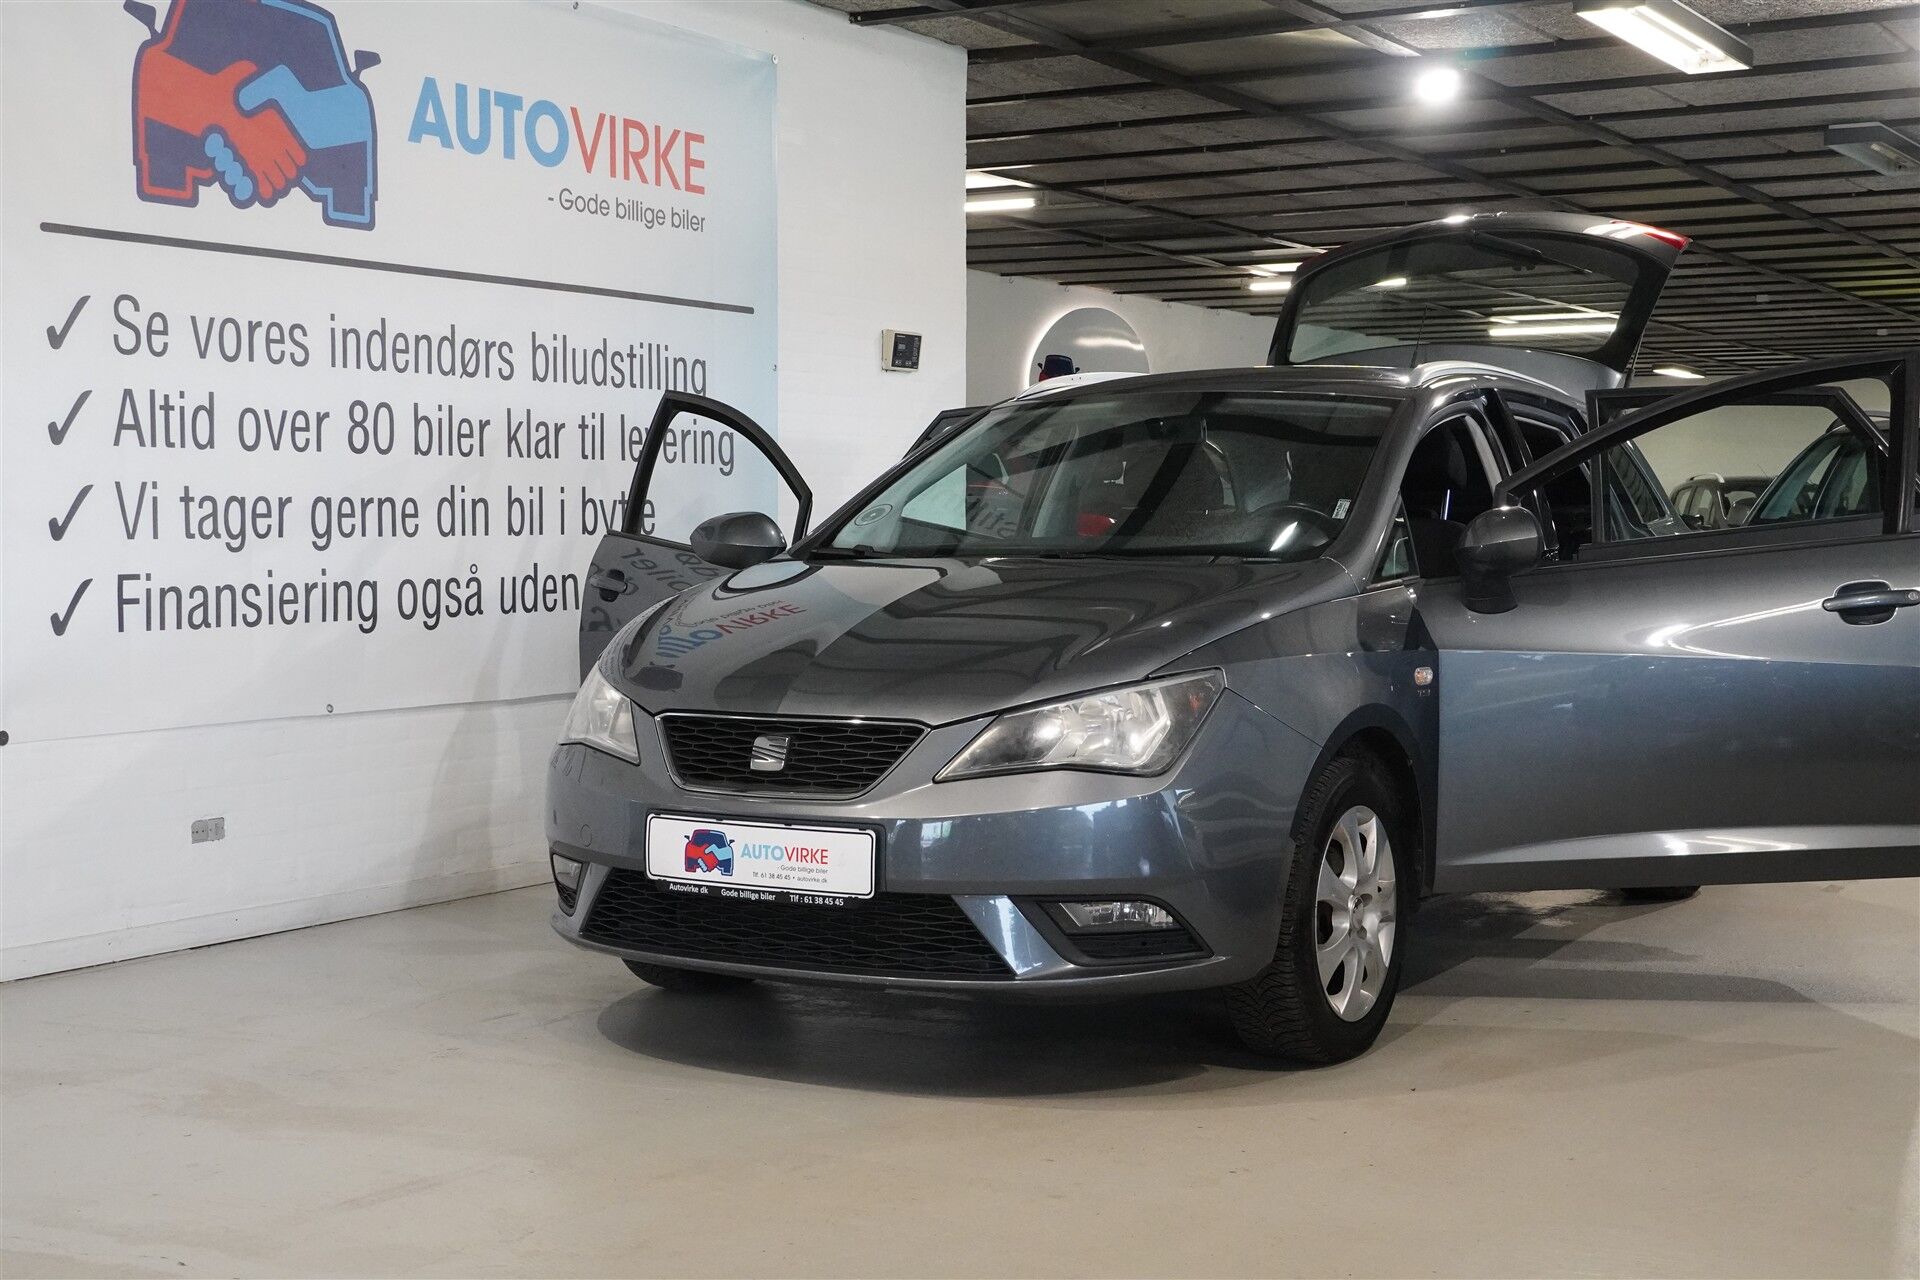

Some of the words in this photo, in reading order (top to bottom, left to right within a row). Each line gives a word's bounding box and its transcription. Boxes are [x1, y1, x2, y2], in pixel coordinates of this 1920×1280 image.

[408, 76, 705, 195] AUTOVIRKE
[559, 187, 610, 217] Gode
[615, 197, 666, 230] billige
[671, 206, 706, 233] biler
[113, 294, 169, 358] Se
[190, 315, 310, 367] vores
[330, 313, 515, 381] indendørs
[531, 331, 707, 397] biludstilling
[113, 388, 215, 451] Altid
[238, 407, 330, 454] over
[347, 400, 395, 456] 80
[413, 402, 490, 458] biler
[506, 407, 566, 460] klar
[577, 412, 605, 461] til
[620, 414, 735, 477] leering
[114, 480, 159, 540] Vi
[179, 485, 293, 553] tager
[310, 496, 419, 552] gerne
[437, 484, 489, 538] din
[507, 485, 544, 537] bil
[560, 486, 565, 535] i
[117, 568, 378, 635] Finansiering
[397, 563, 484, 631] også
[500, 562, 580, 615] uden
[740, 843, 829, 865] AUTOVIRKE
[669, 883, 699, 893] Autovirke
[720, 888, 738, 898] Gode
[740, 890, 760, 900] billige
[760, 892, 776, 900] biler
[814, 896, 823, 904] 38
[824, 897, 833, 905] 45
[834, 898, 844, 906] 45
